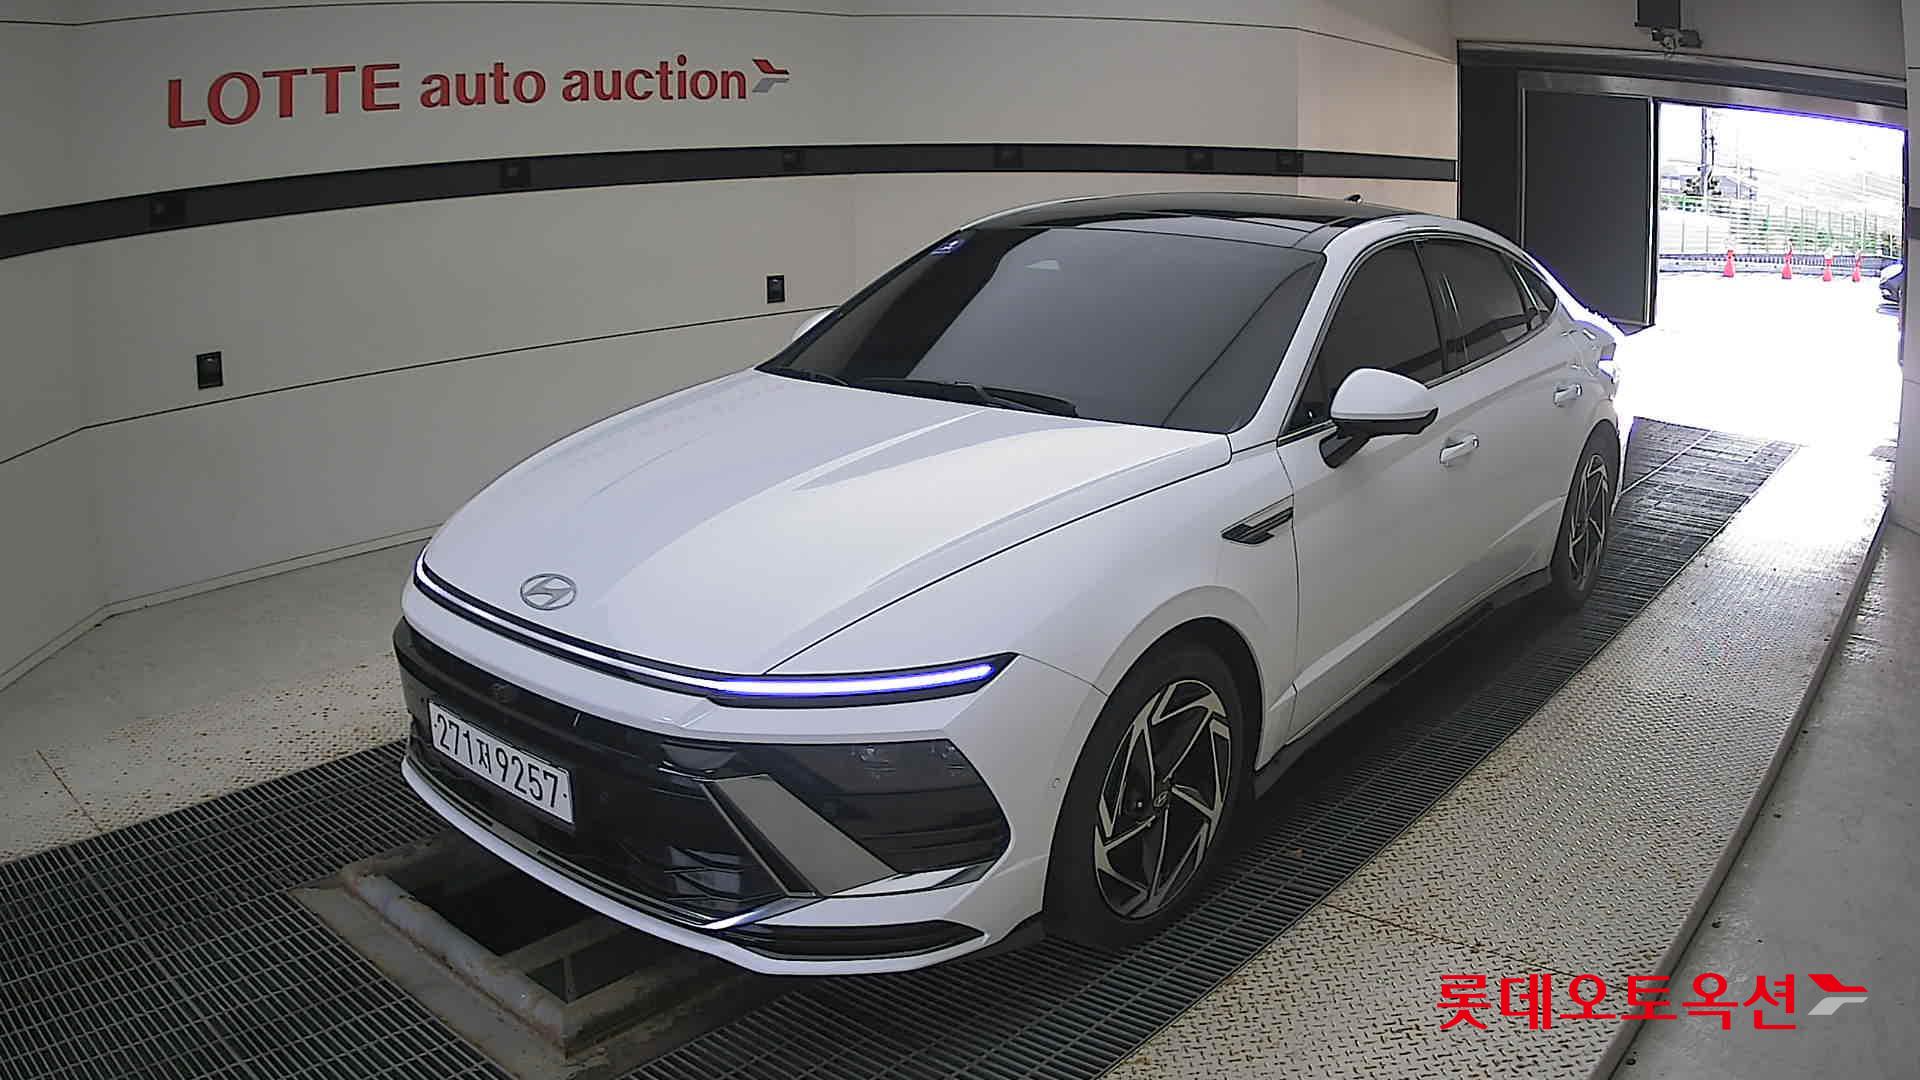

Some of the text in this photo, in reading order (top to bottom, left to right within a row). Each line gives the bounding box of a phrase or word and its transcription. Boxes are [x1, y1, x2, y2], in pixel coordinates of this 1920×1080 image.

[167, 54, 747, 129] LOTTE auto auction
